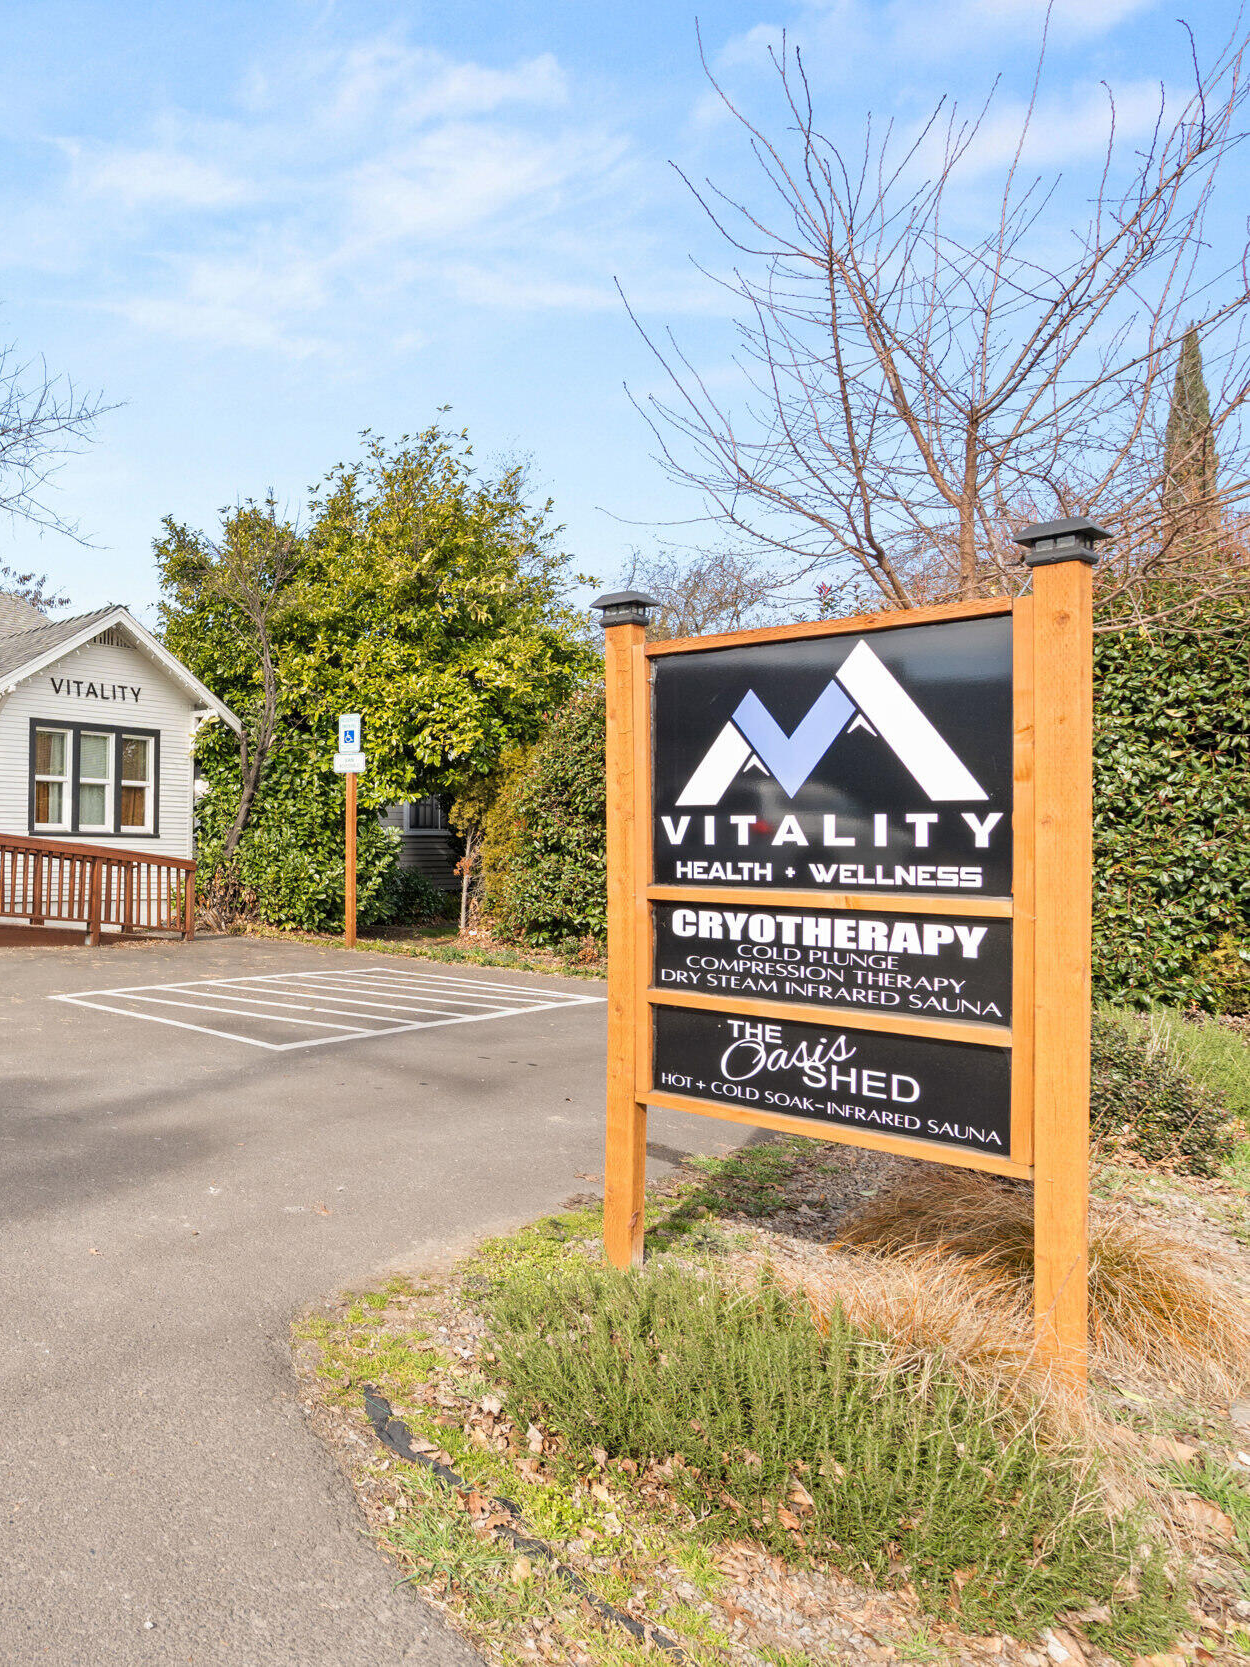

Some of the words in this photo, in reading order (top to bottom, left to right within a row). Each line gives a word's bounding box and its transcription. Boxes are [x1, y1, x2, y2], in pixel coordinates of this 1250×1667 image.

[50, 677, 141, 703] VITALITY
[661, 812, 1004, 849] VITALITY
[676, 861, 773, 882] HEALTH
[808, 863, 983, 888] WELLNESS
[672, 908, 989, 959] CRYOTHERAPY
[686, 955, 844, 983] COMPRESSION
[853, 970, 966, 994] THERAPY
[737, 944, 801, 961] COLD
[809, 950, 899, 971] PLUNGE
[661, 968, 702, 984] DRY
[706, 973, 778, 994] STEAM
[785, 981, 900, 1006] INFRARED
[909, 994, 1003, 1018] SAUNA
[727, 1019, 782, 1044] THE
[720, 1034, 857, 1081] Oasis
[802, 1064, 920, 1103] SHED
[661, 1072, 693, 1089] HOT
[711, 1081, 760, 1101] COLD
[928, 1119, 1002, 1146] SAUNA
